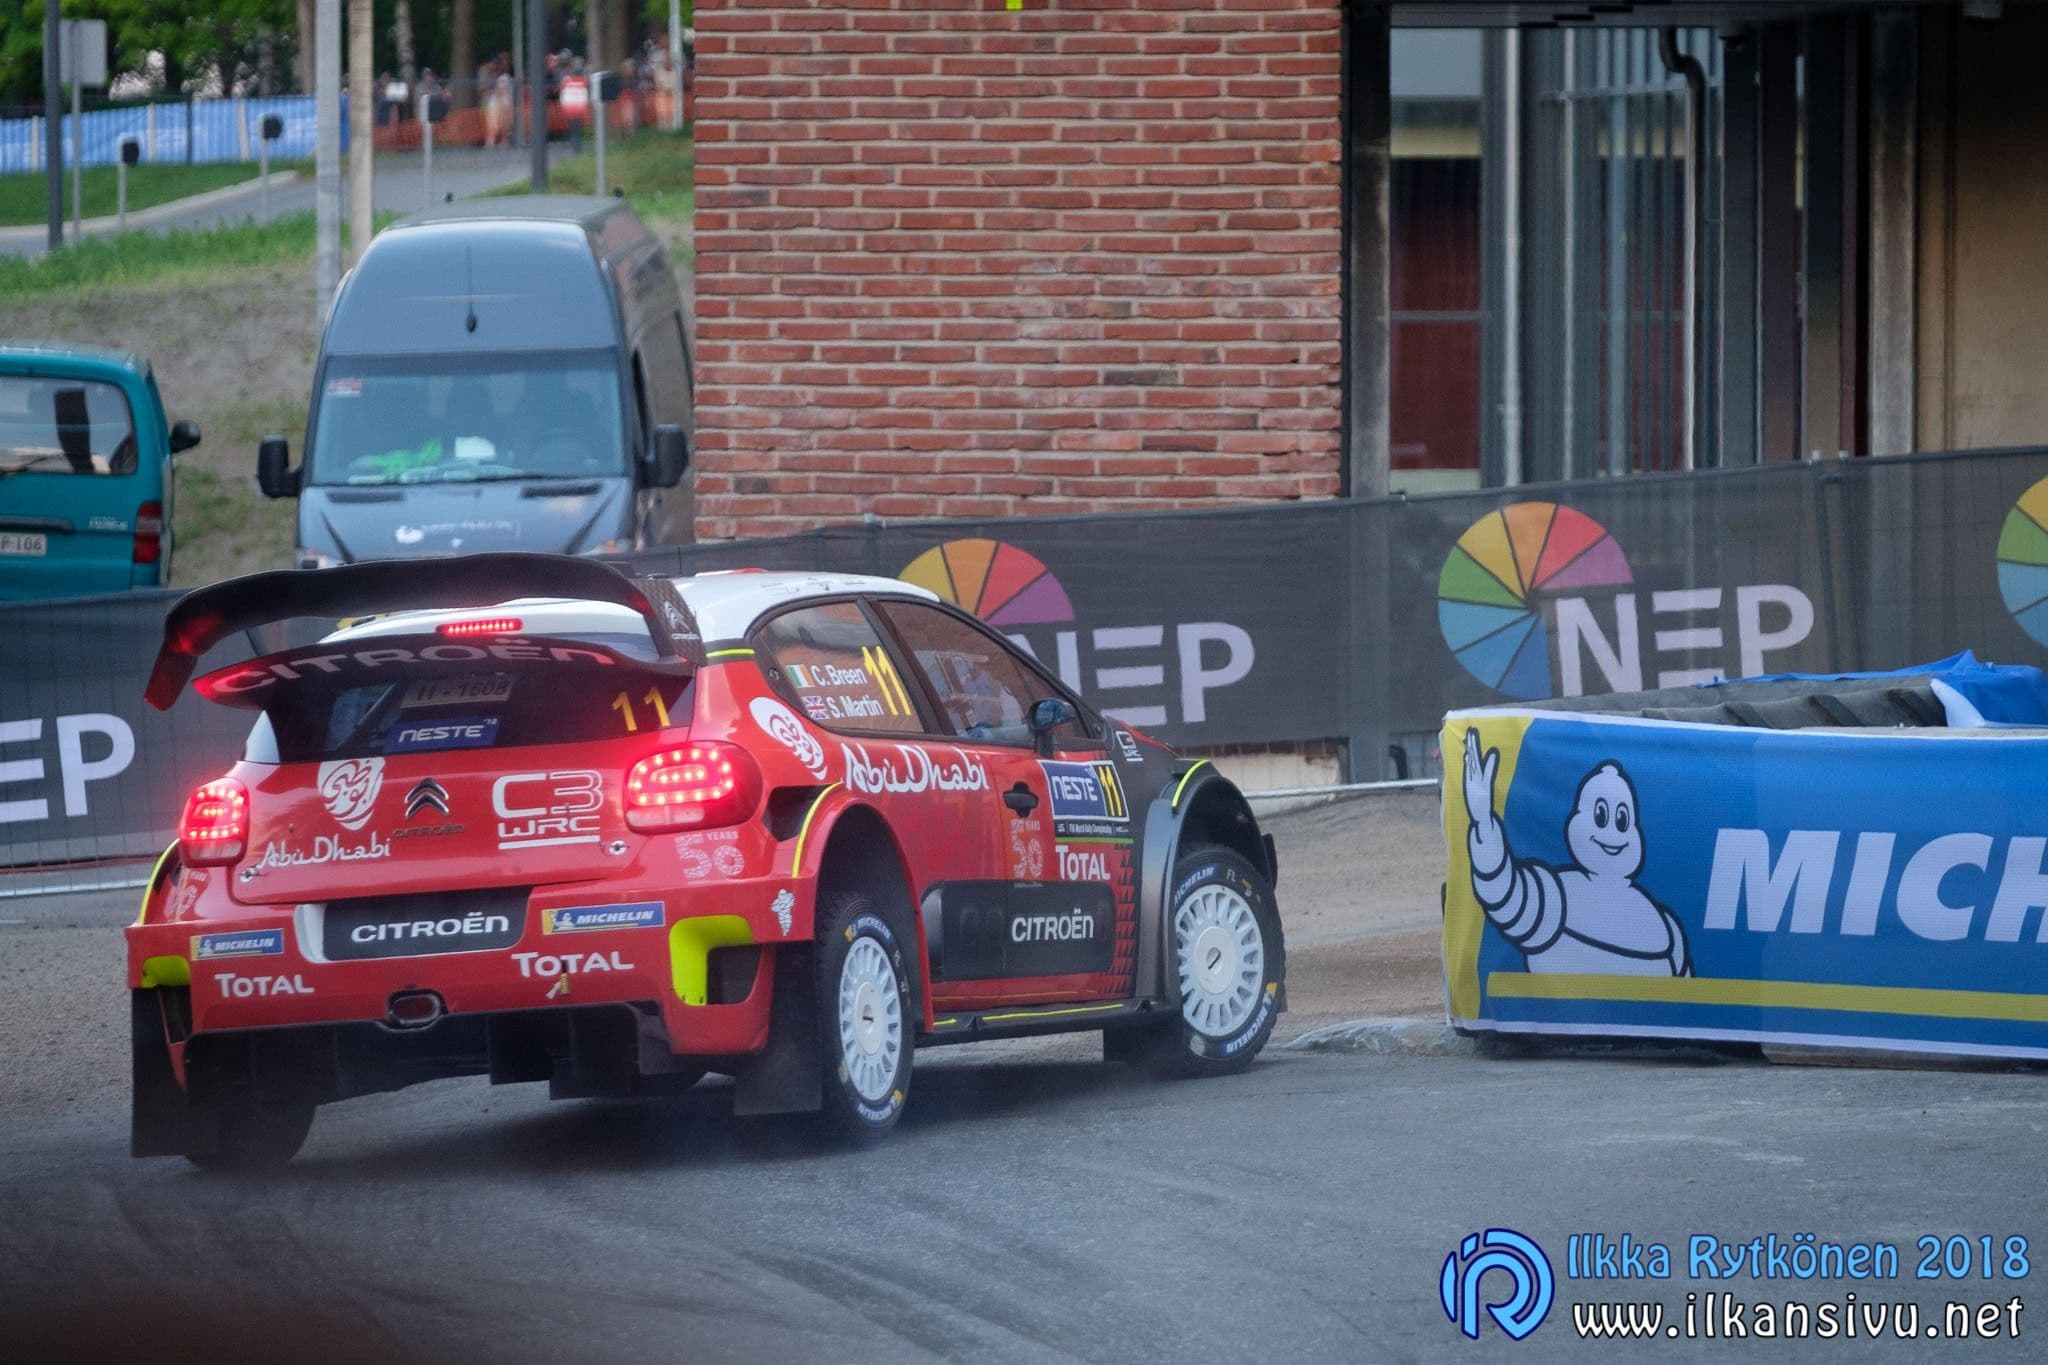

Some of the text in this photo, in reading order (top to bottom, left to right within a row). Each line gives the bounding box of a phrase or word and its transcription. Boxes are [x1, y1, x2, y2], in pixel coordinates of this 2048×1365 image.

[1556, 584, 1814, 697] NEP
[825, 664, 868, 686] Breen
[862, 646, 911, 715] 11
[611, 687, 670, 732] 11
[840, 694, 884, 717] Martin
[398, 725, 485, 743] NESTE
[492, 769, 604, 818] C3
[1050, 775, 1098, 801] NESTE
[1098, 765, 1122, 817] 11
[498, 815, 600, 838] WRC
[1055, 845, 1111, 881] TOTAL
[576, 911, 654, 924] MICHELIN
[214, 938, 275, 951] MICHELIN
[511, 951, 635, 978] TOTAL
[214, 973, 315, 998] TOTAL
